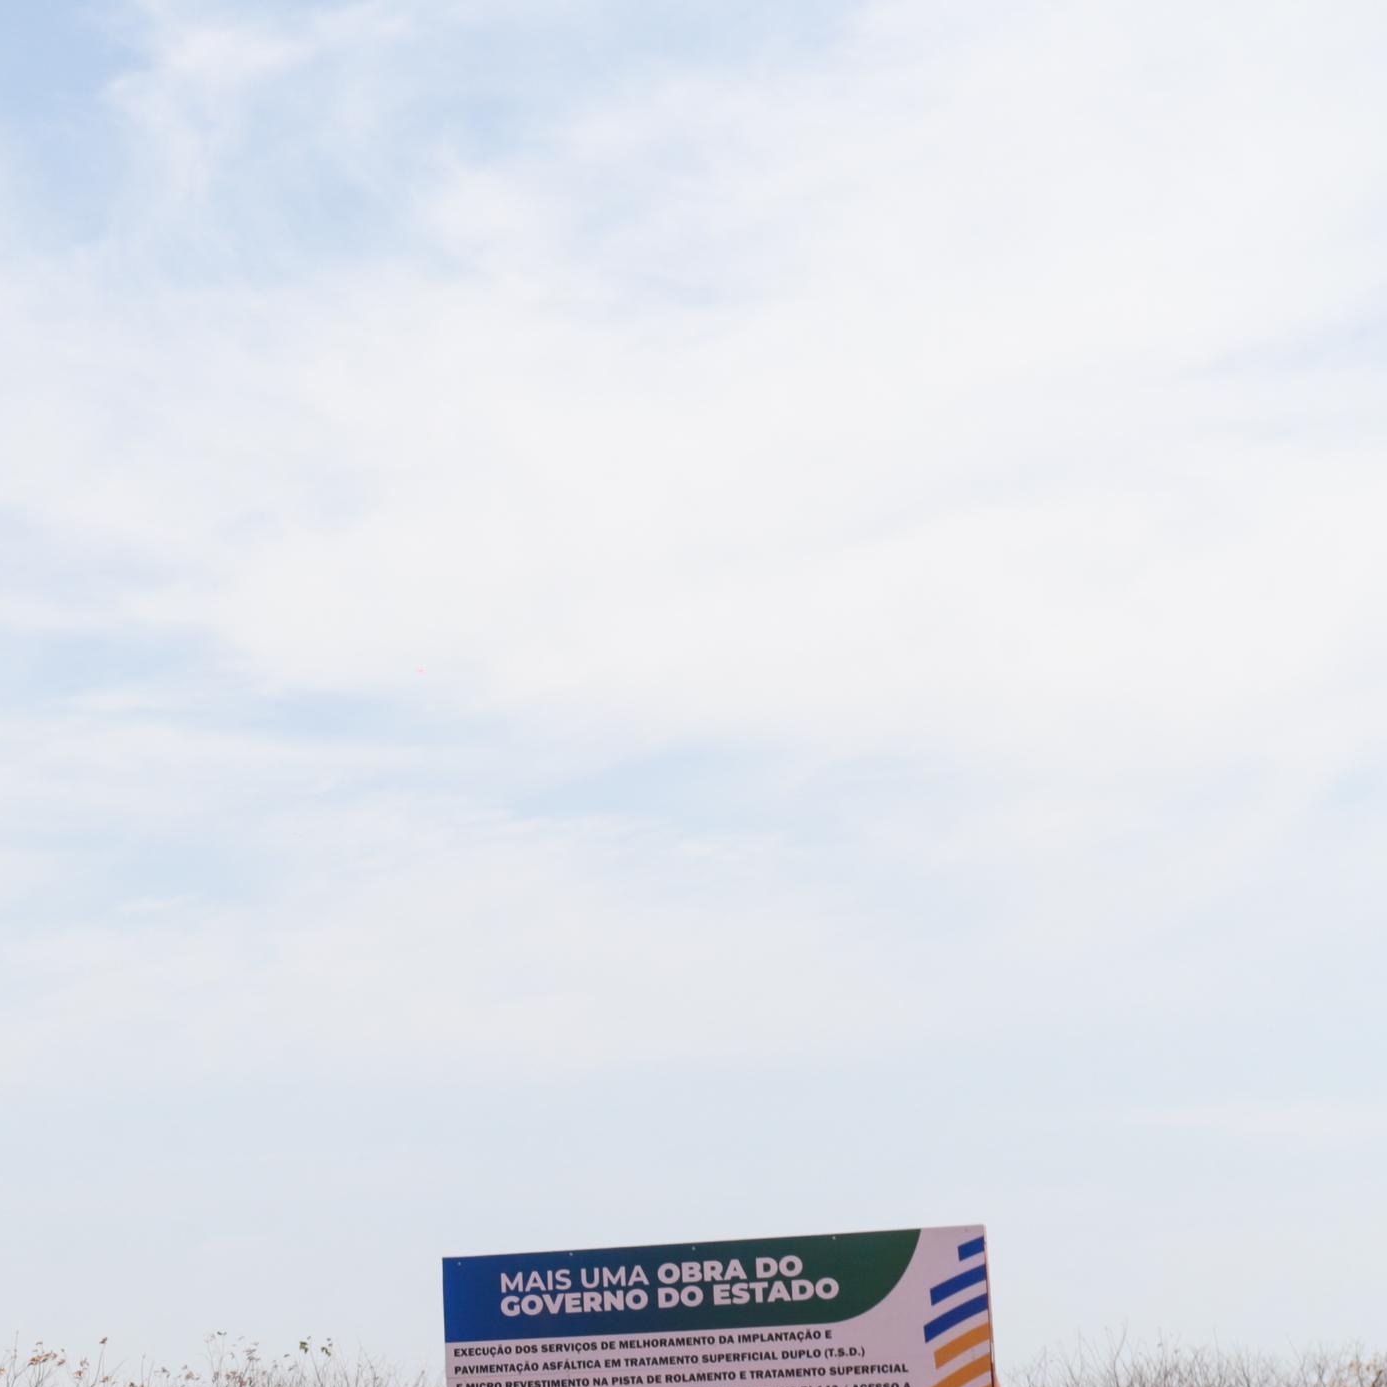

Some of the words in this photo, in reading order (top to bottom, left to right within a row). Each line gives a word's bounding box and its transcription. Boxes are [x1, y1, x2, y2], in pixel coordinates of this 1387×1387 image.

[501, 1269, 571, 1293] MAIS
[581, 1265, 649, 1289] UMA
[658, 1259, 747, 1285] OBRA
[755, 1255, 803, 1279] DO
[501, 1287, 649, 1318] GOVERNO
[658, 1285, 704, 1310] DO
[714, 1277, 840, 1306] ESTADO
[453, 1345, 512, 1358] EXECUÇÃO
[515, 1345, 538, 1354] DOS
[541, 1342, 597, 1354] SERVIÇOS
[601, 1340, 616, 1350] DE
[619, 1336, 715, 1349] MELHORAMENTO
[719, 1335, 735, 1344] DA
[737, 1330, 821, 1344] IMPLANTAÇÃO
[825, 1330, 832, 1338] E
[455, 1361, 539, 1376] PAVIMENTAÇÃO
[543, 1358, 601, 1371] ASFÁLTICA
[605, 1358, 621, 1368] EM
[625, 1354, 699, 1367] TRATAMENTO
[702, 1351, 778, 1364] SUPERFICIAL
[781, 1349, 821, 1360] DUPLO
[825, 1346, 865, 1359] (T.S.D.)
[593, 1377, 609, 1386] NA
[611, 1376, 643, 1386] PISTA
[647, 1374, 662, 1384] DE
[665, 1371, 736, 1383] ROLAMENTO
[739, 1370, 747, 1380] E
[749, 1367, 826, 1380] TRATAMENTO
[829, 1363, 909, 1376] SUPERFICIAL
